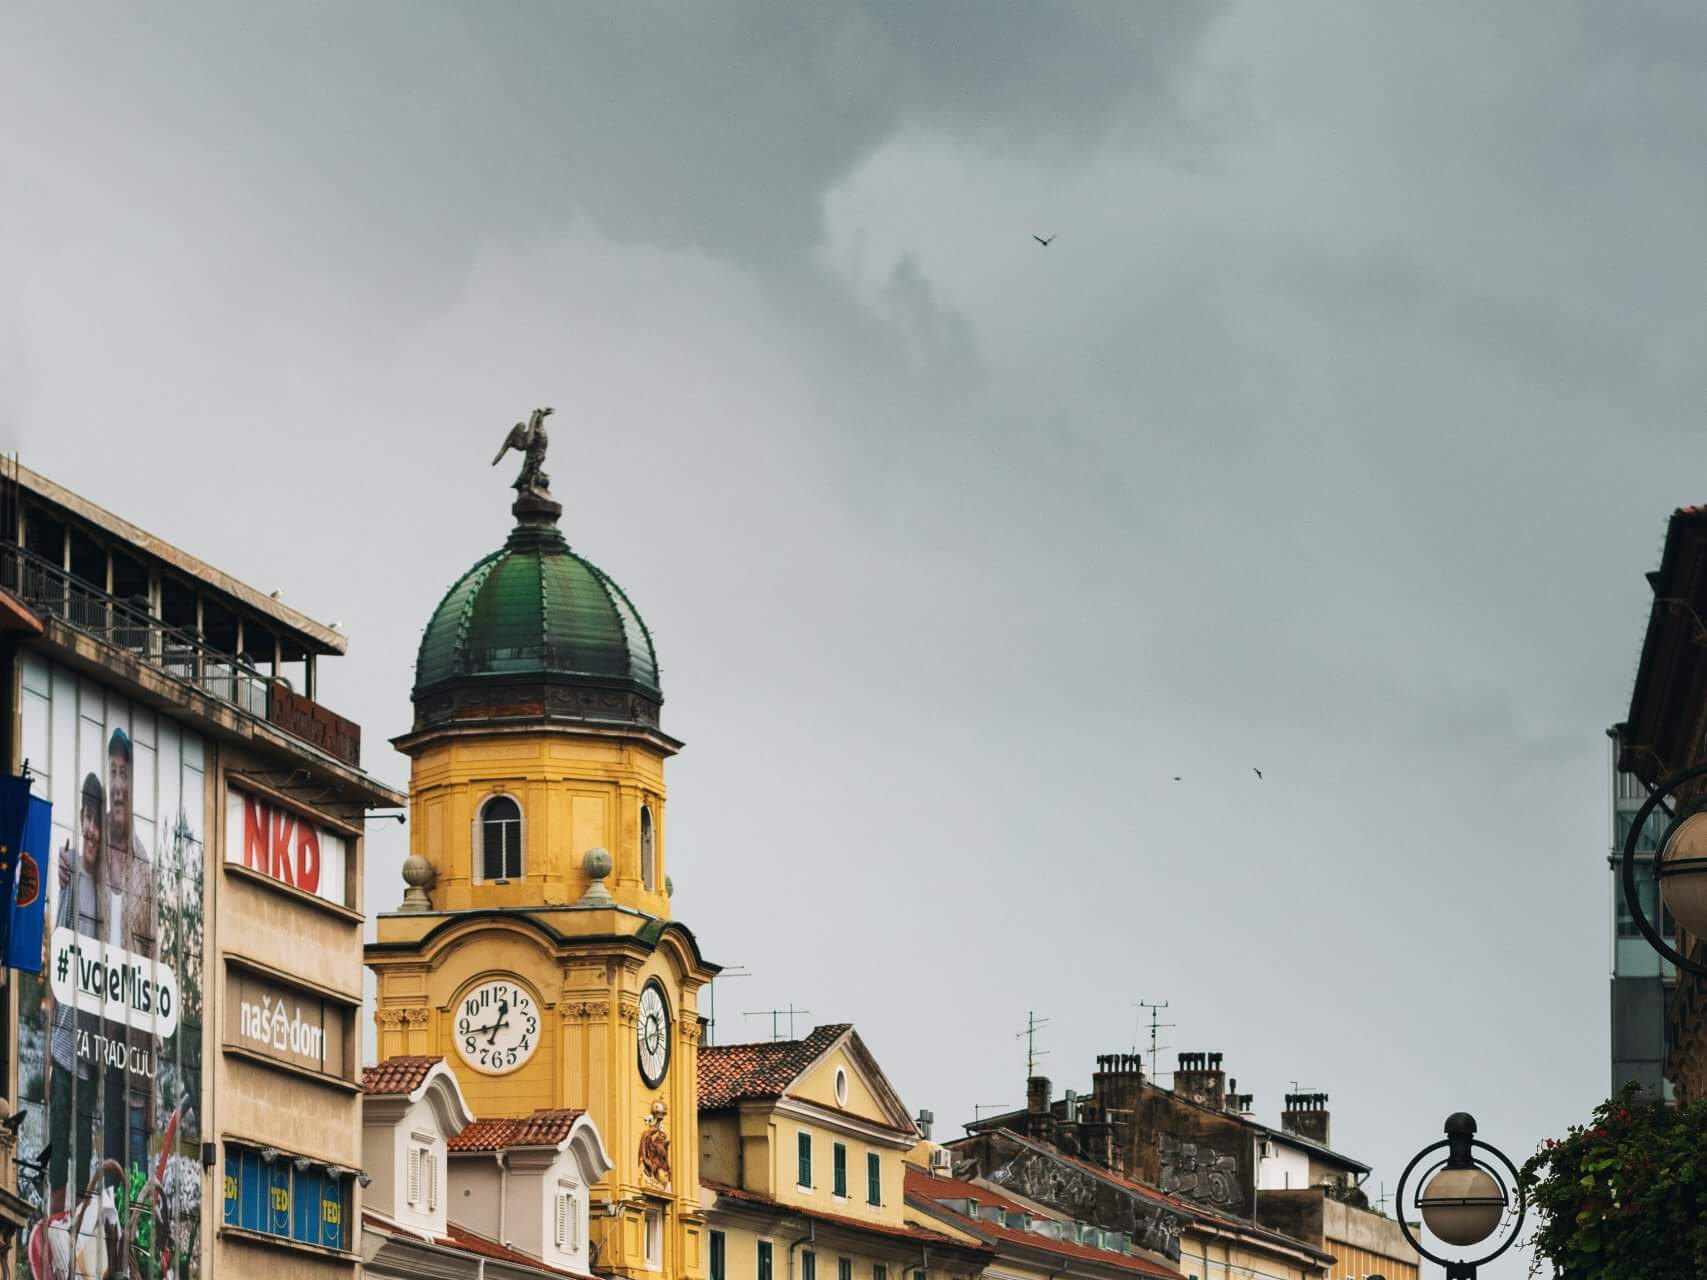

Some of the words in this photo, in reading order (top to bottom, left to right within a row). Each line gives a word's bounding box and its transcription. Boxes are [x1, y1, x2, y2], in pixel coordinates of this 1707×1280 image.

[244, 796, 320, 895] NKD
[480, 989, 489, 1007] 11
[492, 986, 507, 1003] 12
[512, 990, 518, 1007] 1
[465, 999, 479, 1016] 10
[520, 999, 529, 1016] 2
[241, 994, 272, 1044] naš
[459, 1018, 470, 1035] 9
[526, 1016, 536, 1034] 3
[465, 1036, 477, 1054] 8
[518, 1034, 529, 1051] 4
[94, 1034, 158, 1078] TRADCIJU
[480, 1048, 489, 1065] 7
[491, 1051, 503, 1069] 6
[506, 1047, 518, 1065] 5
[224, 1175, 238, 1201] EDi
[271, 1187, 289, 1212] TED
[322, 1200, 341, 1225] TEDi
